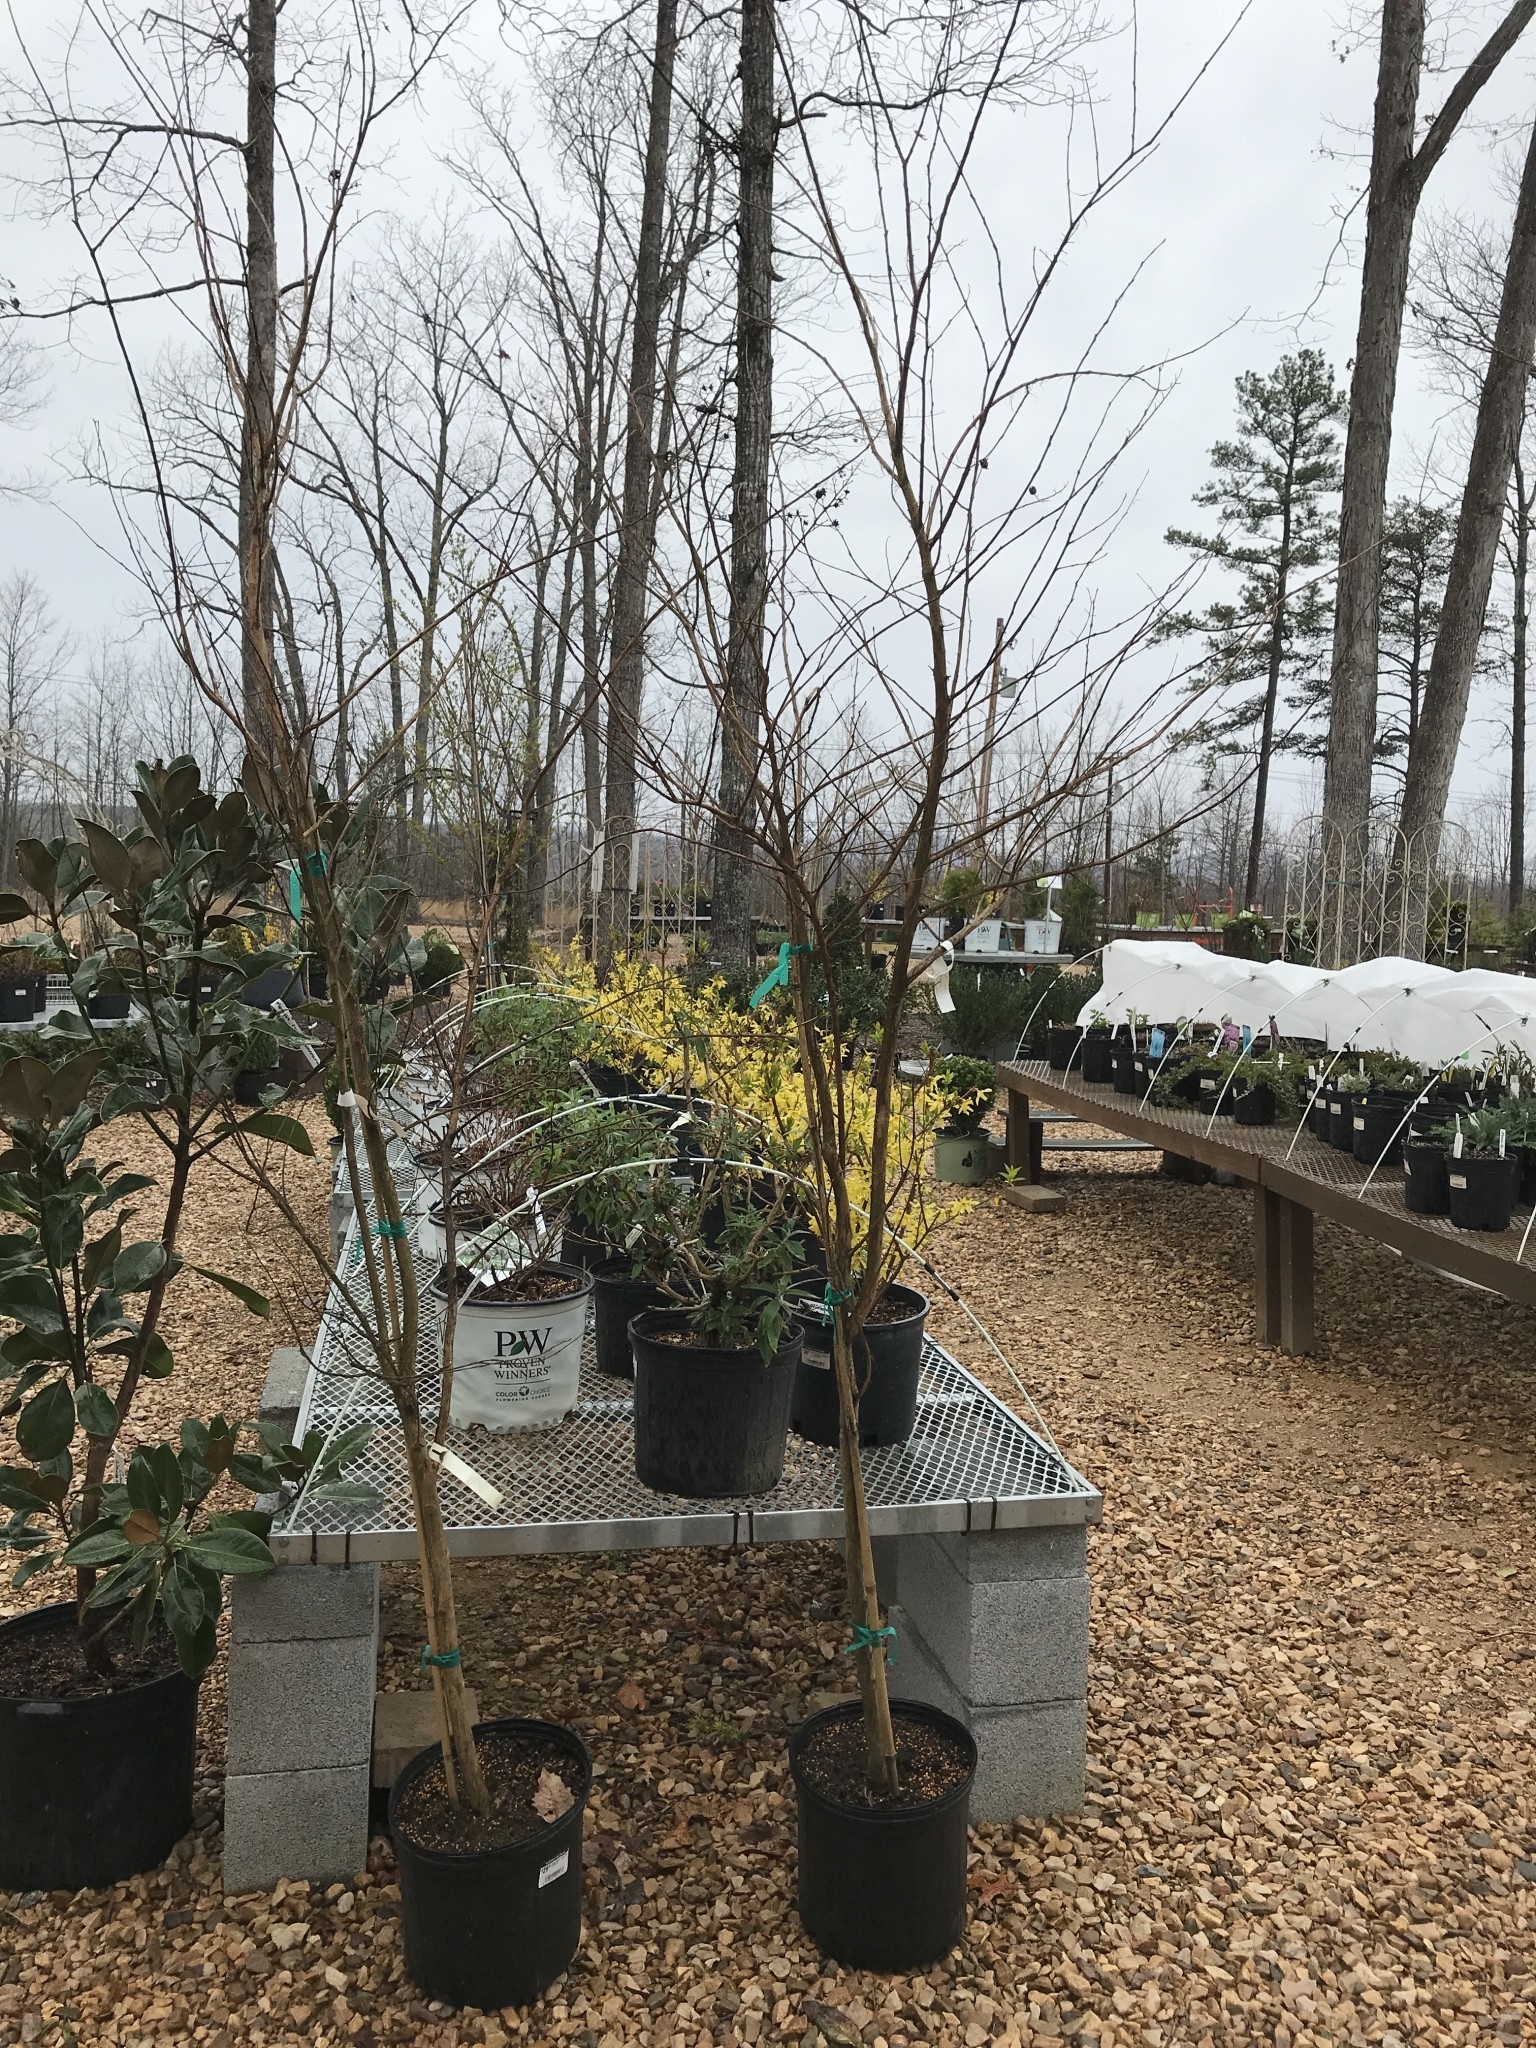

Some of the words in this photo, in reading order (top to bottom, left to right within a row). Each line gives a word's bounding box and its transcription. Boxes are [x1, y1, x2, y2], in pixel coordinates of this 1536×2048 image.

[494, 1327, 553, 1356] PW
[498, 1356, 545, 1368] PROVEN
[494, 1366, 550, 1379] WINNERS
